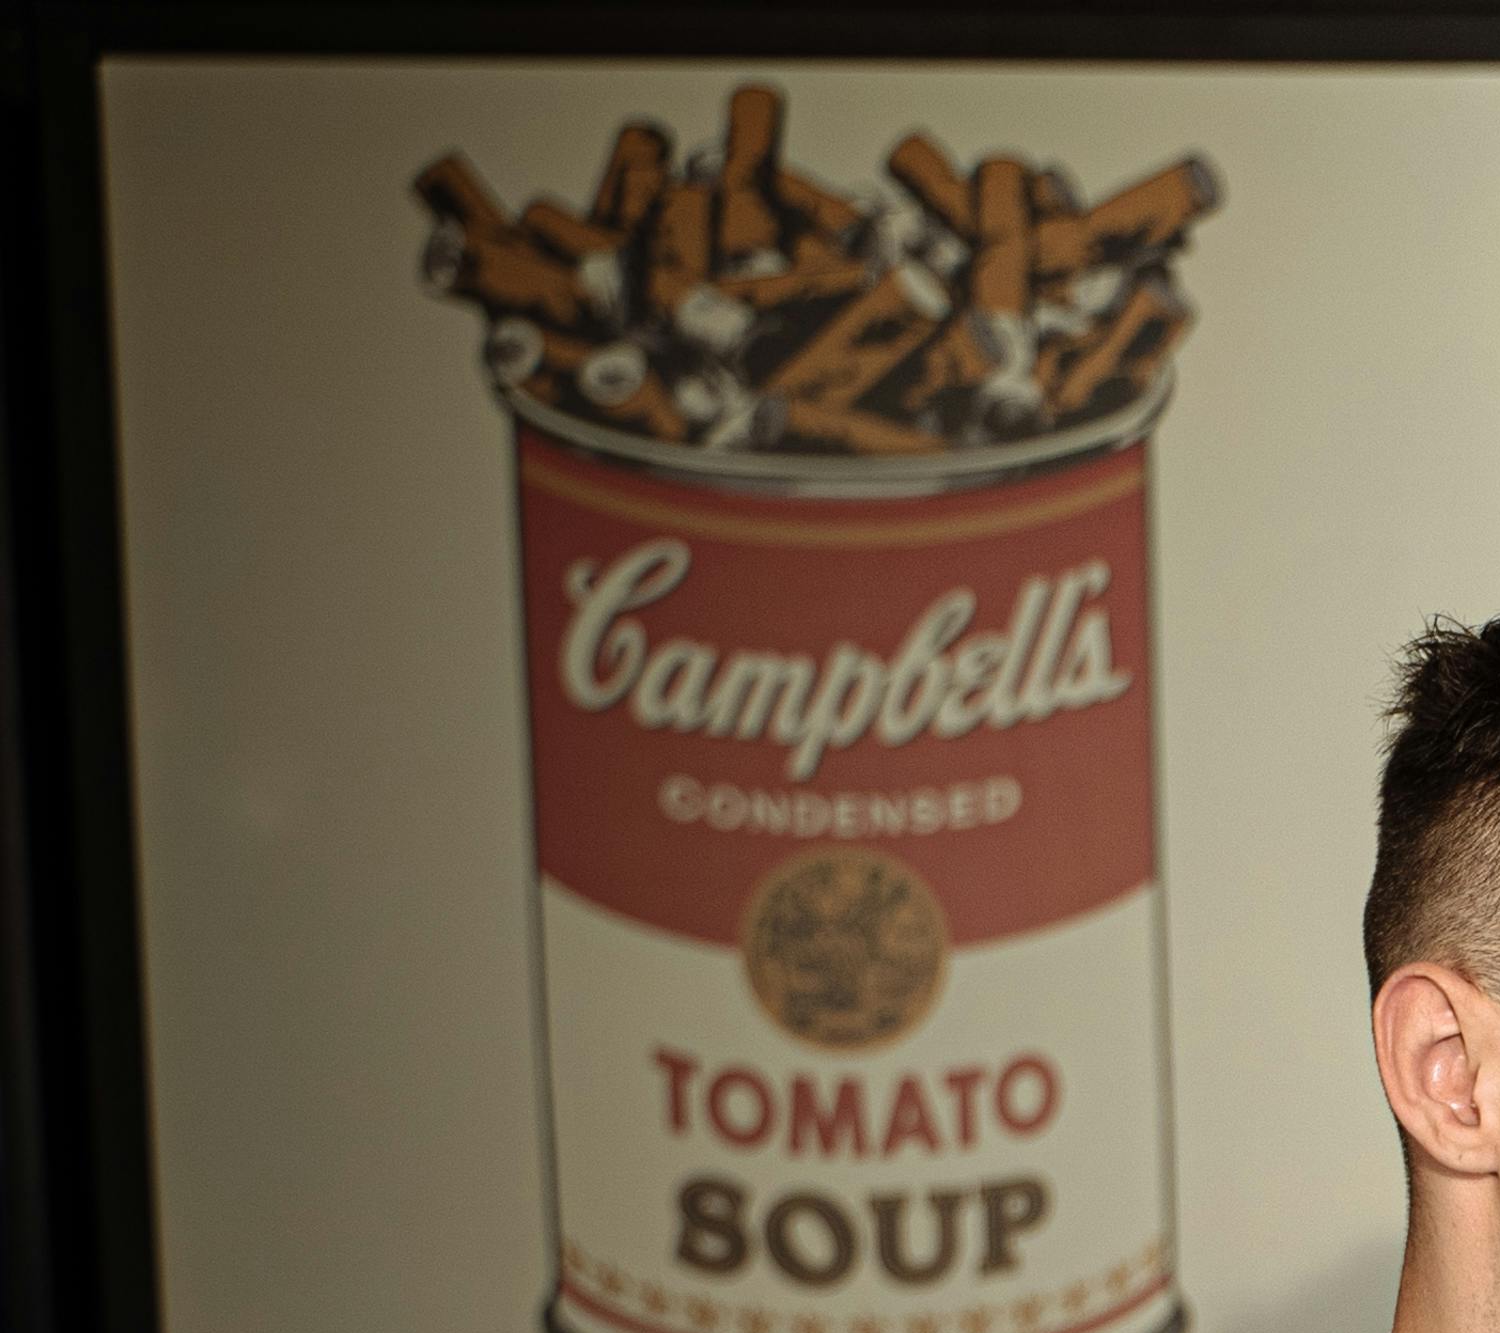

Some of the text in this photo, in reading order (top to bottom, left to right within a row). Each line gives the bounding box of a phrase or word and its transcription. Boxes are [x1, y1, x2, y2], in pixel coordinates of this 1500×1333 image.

[562, 539, 1132, 781] Campbell's
[659, 776, 1021, 838] CONDENSED
[654, 1048, 1062, 1160] TOMATO
[677, 1172, 1050, 1287] SOUP
